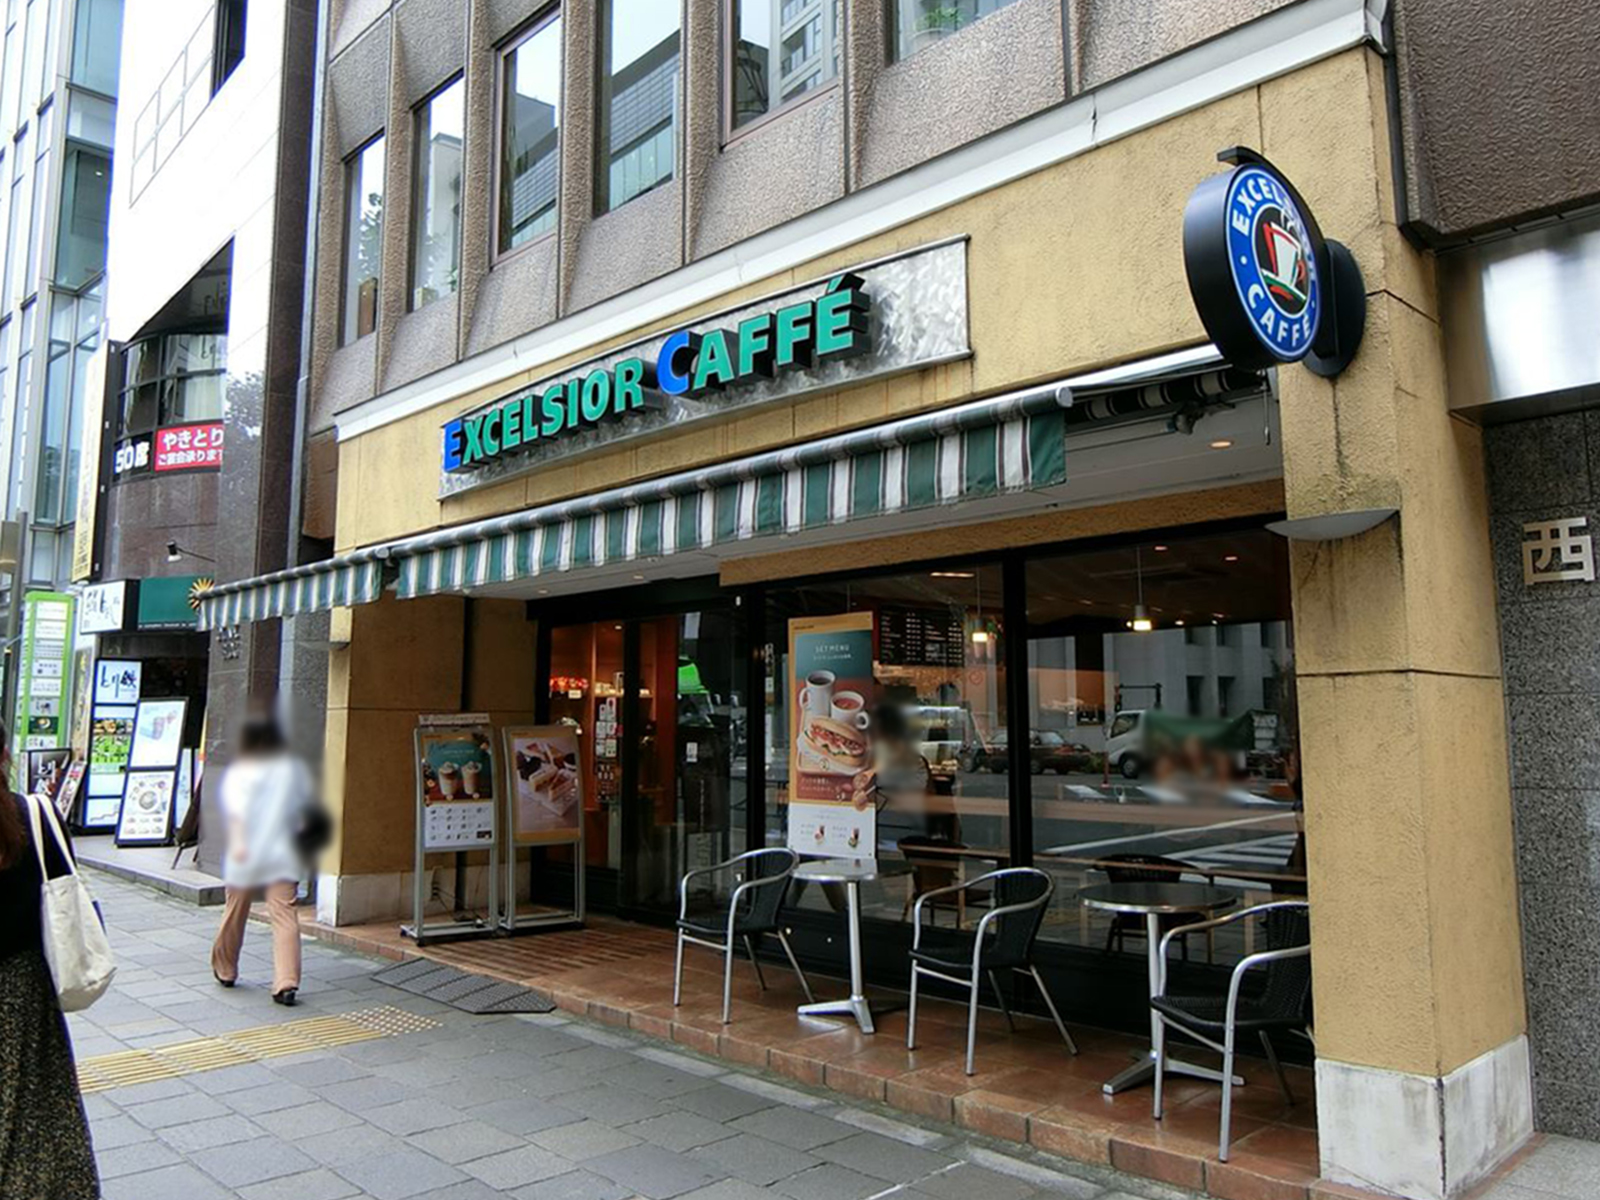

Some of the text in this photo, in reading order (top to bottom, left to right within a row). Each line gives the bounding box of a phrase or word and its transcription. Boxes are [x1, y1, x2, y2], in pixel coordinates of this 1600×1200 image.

[1232, 177, 1317, 281] EXCEL
[443, 276, 858, 473] EXCELSIOR CAFFÉ
[163, 427, 224, 450] やきとり
[1522, 516, 1595, 585] 西
